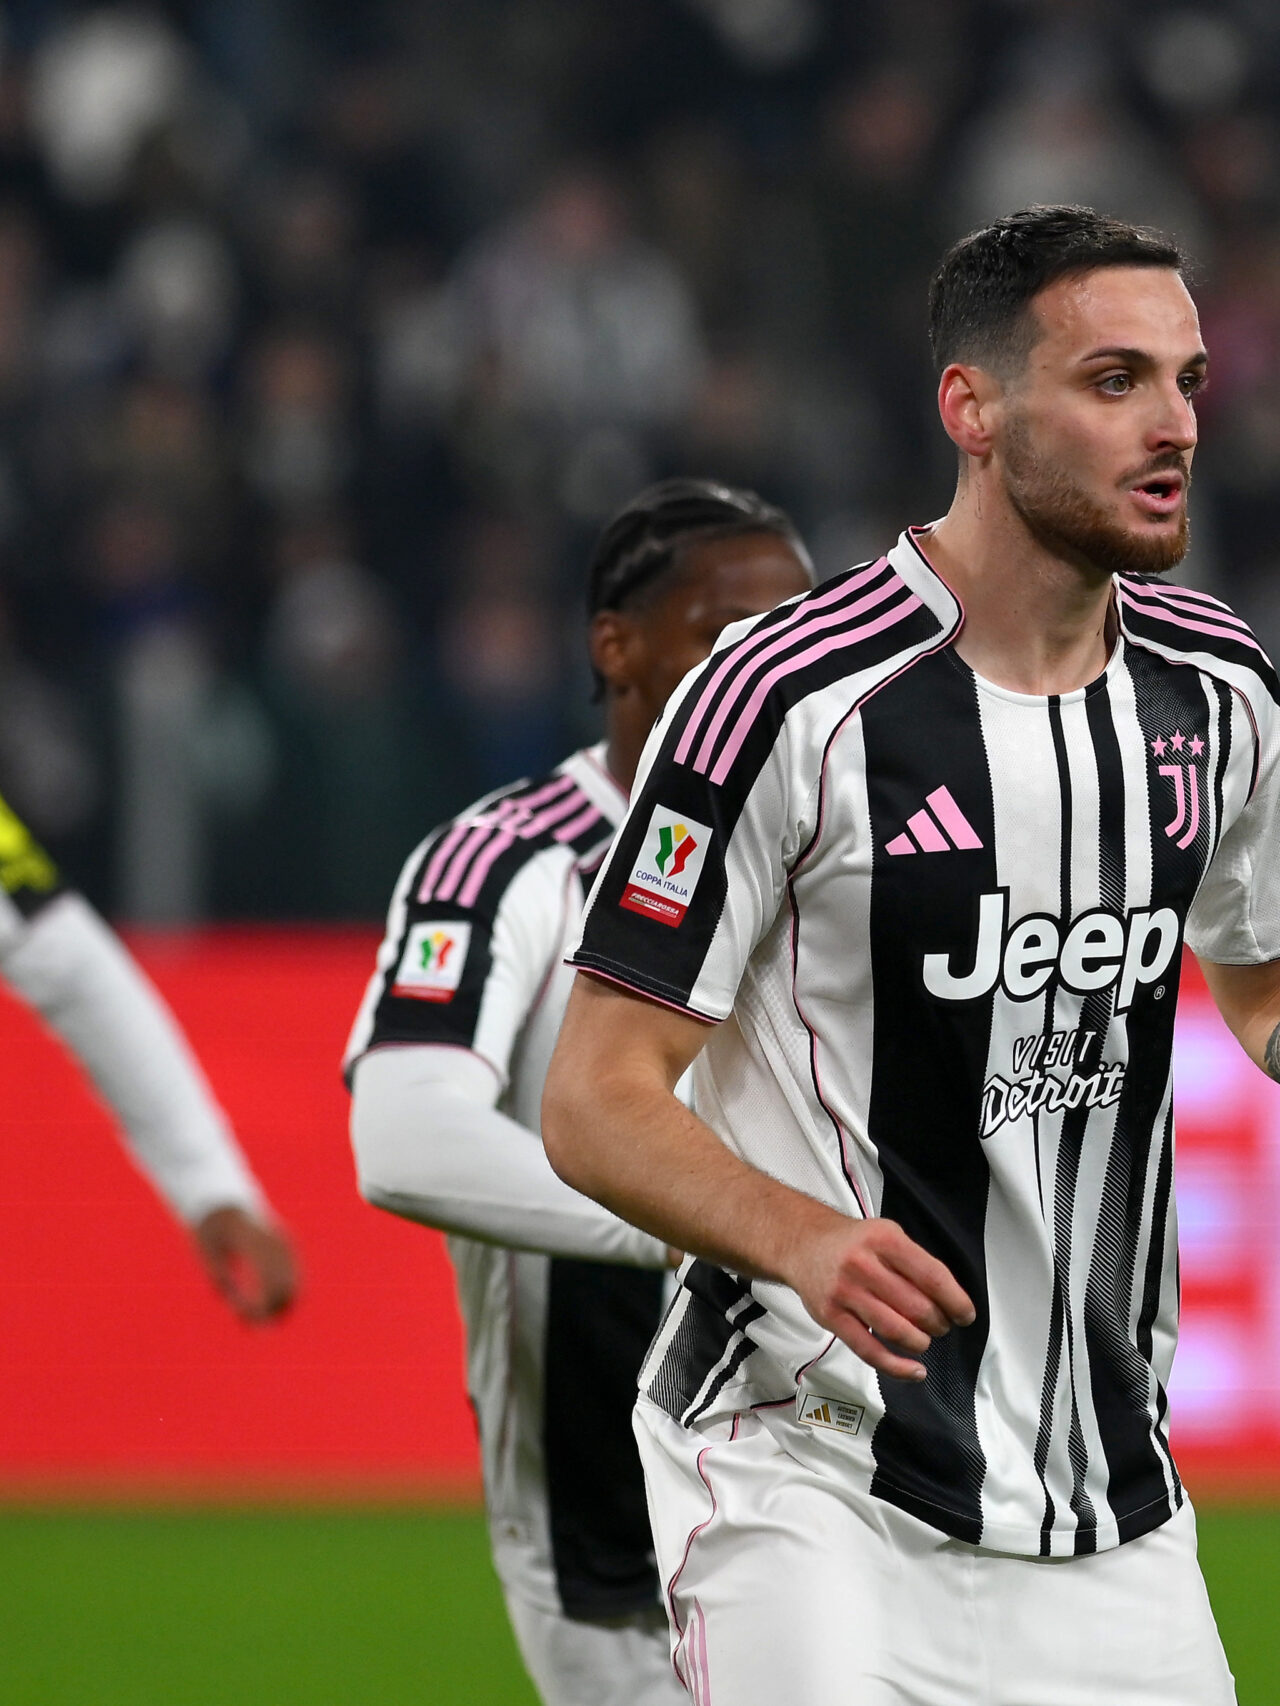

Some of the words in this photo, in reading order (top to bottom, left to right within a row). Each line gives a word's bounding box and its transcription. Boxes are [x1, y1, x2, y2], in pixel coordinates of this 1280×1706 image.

[635, 869, 662, 888] COPPA
[663, 880, 688, 898] ITALIA
[922, 892, 1179, 1010] Jeep
[1012, 1030, 1097, 1073] VISIT
[980, 1063, 1126, 1138] Detroit
